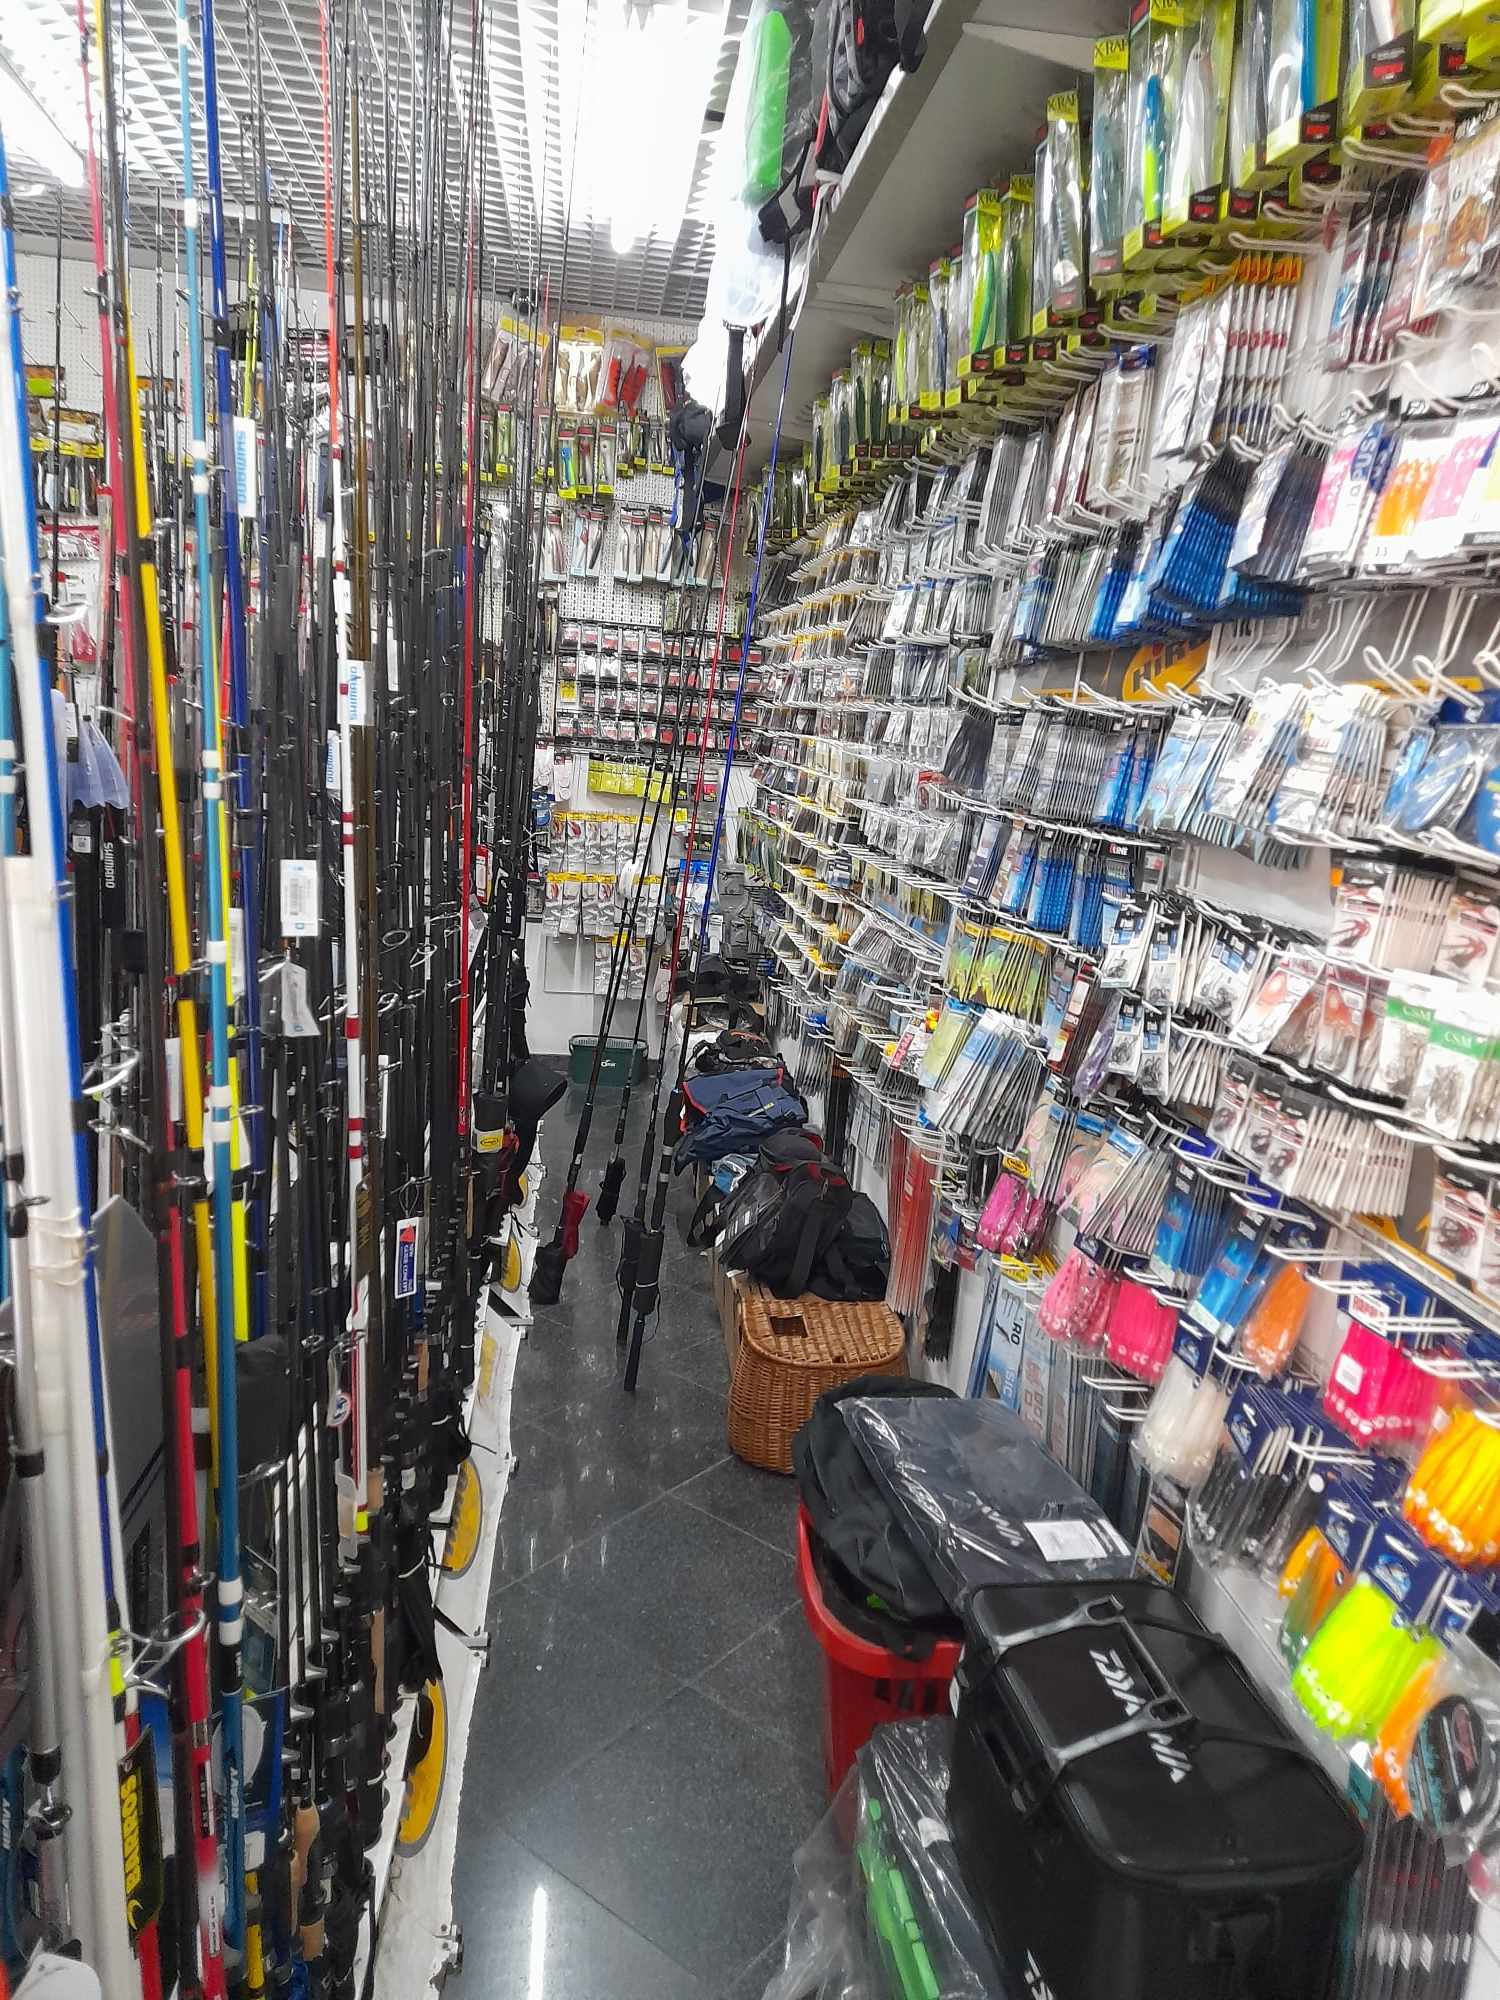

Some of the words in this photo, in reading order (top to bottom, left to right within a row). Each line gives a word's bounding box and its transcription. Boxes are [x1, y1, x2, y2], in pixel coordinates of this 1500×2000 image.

[103, 842, 116, 889] SHIMANO
[230, 1766, 241, 1818] HEAVY
[2, 1797, 11, 1851] HEAVY
